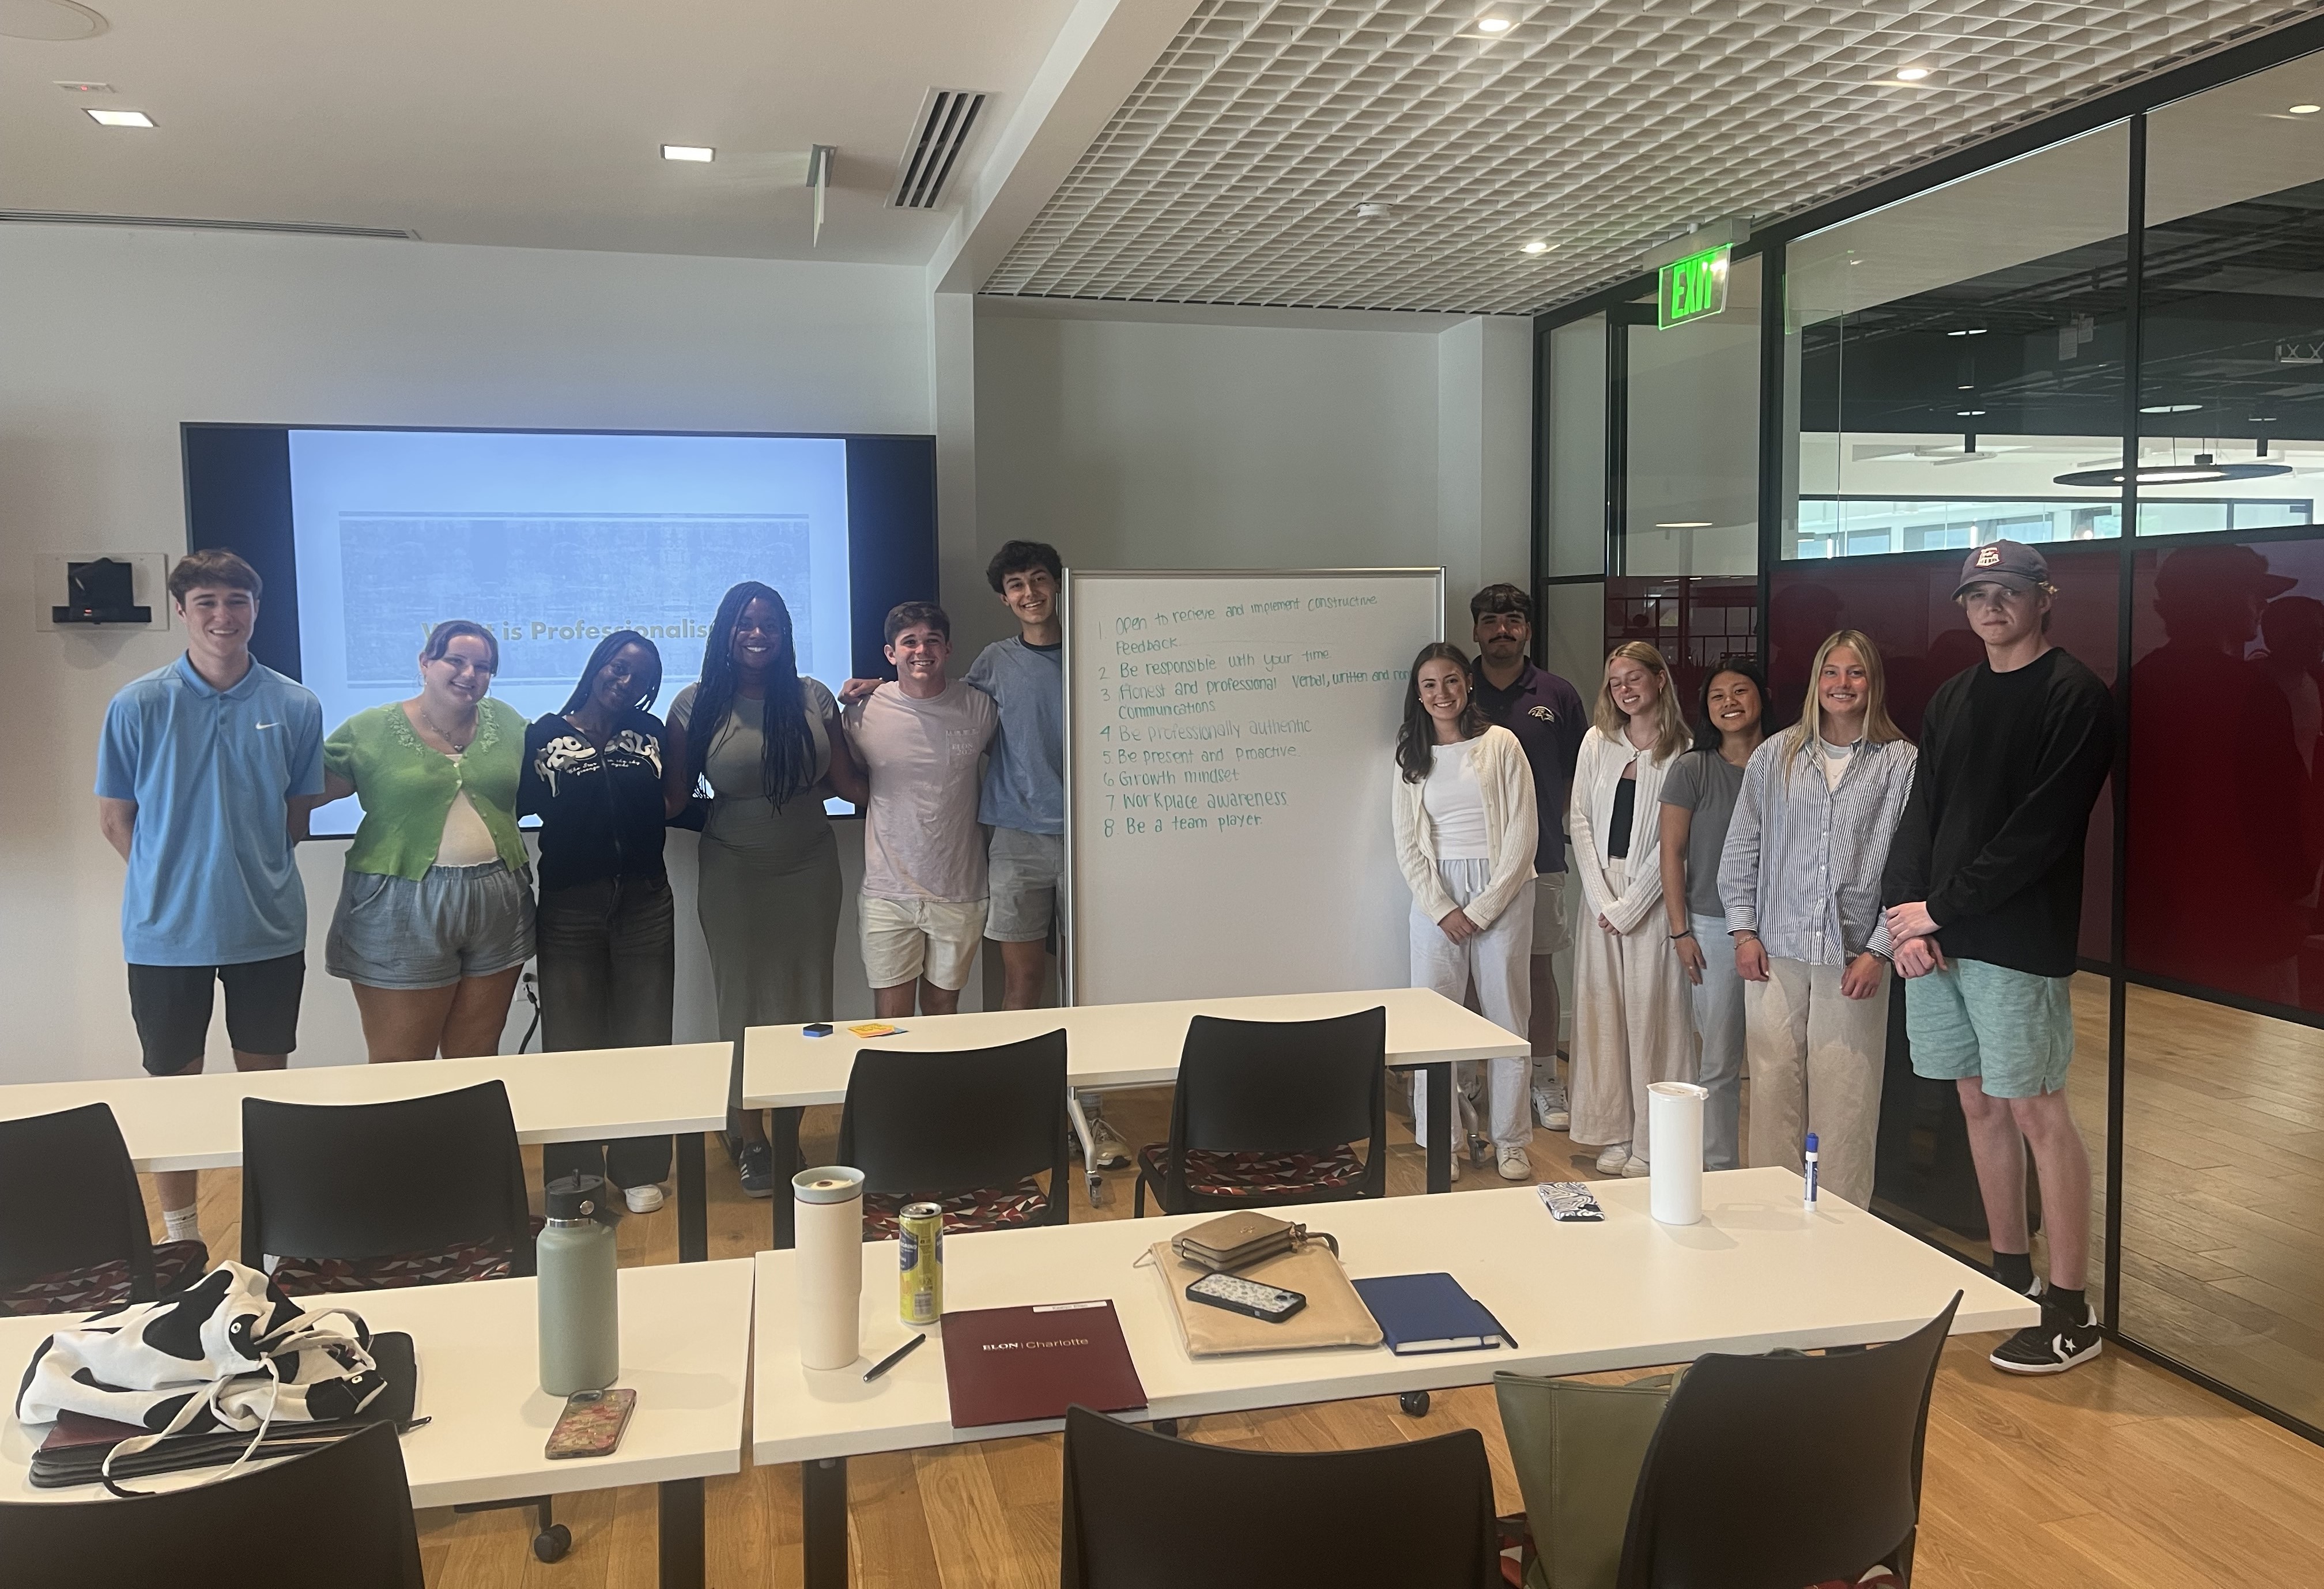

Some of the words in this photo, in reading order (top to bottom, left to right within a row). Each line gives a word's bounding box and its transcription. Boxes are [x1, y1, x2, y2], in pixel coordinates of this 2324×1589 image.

[1672, 252, 1716, 319] EXIT
[1155, 612, 1168, 625] to
[1226, 605, 1244, 617] and
[1251, 598, 1300, 615] implement
[503, 621, 522, 640] is
[1120, 662, 1138, 677] Be
[1146, 659, 1217, 675] responsible
[1228, 654, 1255, 667] with
[1264, 654, 1293, 672] your
[1120, 684, 1165, 700] Honest
[1175, 681, 1198, 695] and
[1206, 677, 1277, 695] professional
[1333, 671, 1368, 684] written
[1372, 670, 1389, 681] and
[1119, 725, 1141, 741] Be
[1148, 720, 1240, 742] professionally
[1249, 719, 1312, 735] authentic
[1118, 749, 1137, 764] Be
[1144, 749, 1194, 765] present
[1201, 748, 1224, 762] and
[1119, 770, 1175, 786] Growth
[1184, 768, 1240, 784] mindset
[1126, 817, 1145, 835] Be
[1155, 818, 1163, 832] a
[1172, 816, 1208, 831] team
[983, 1342, 1018, 1350] ELON
[1026, 1338, 1089, 1349] Charlotte
